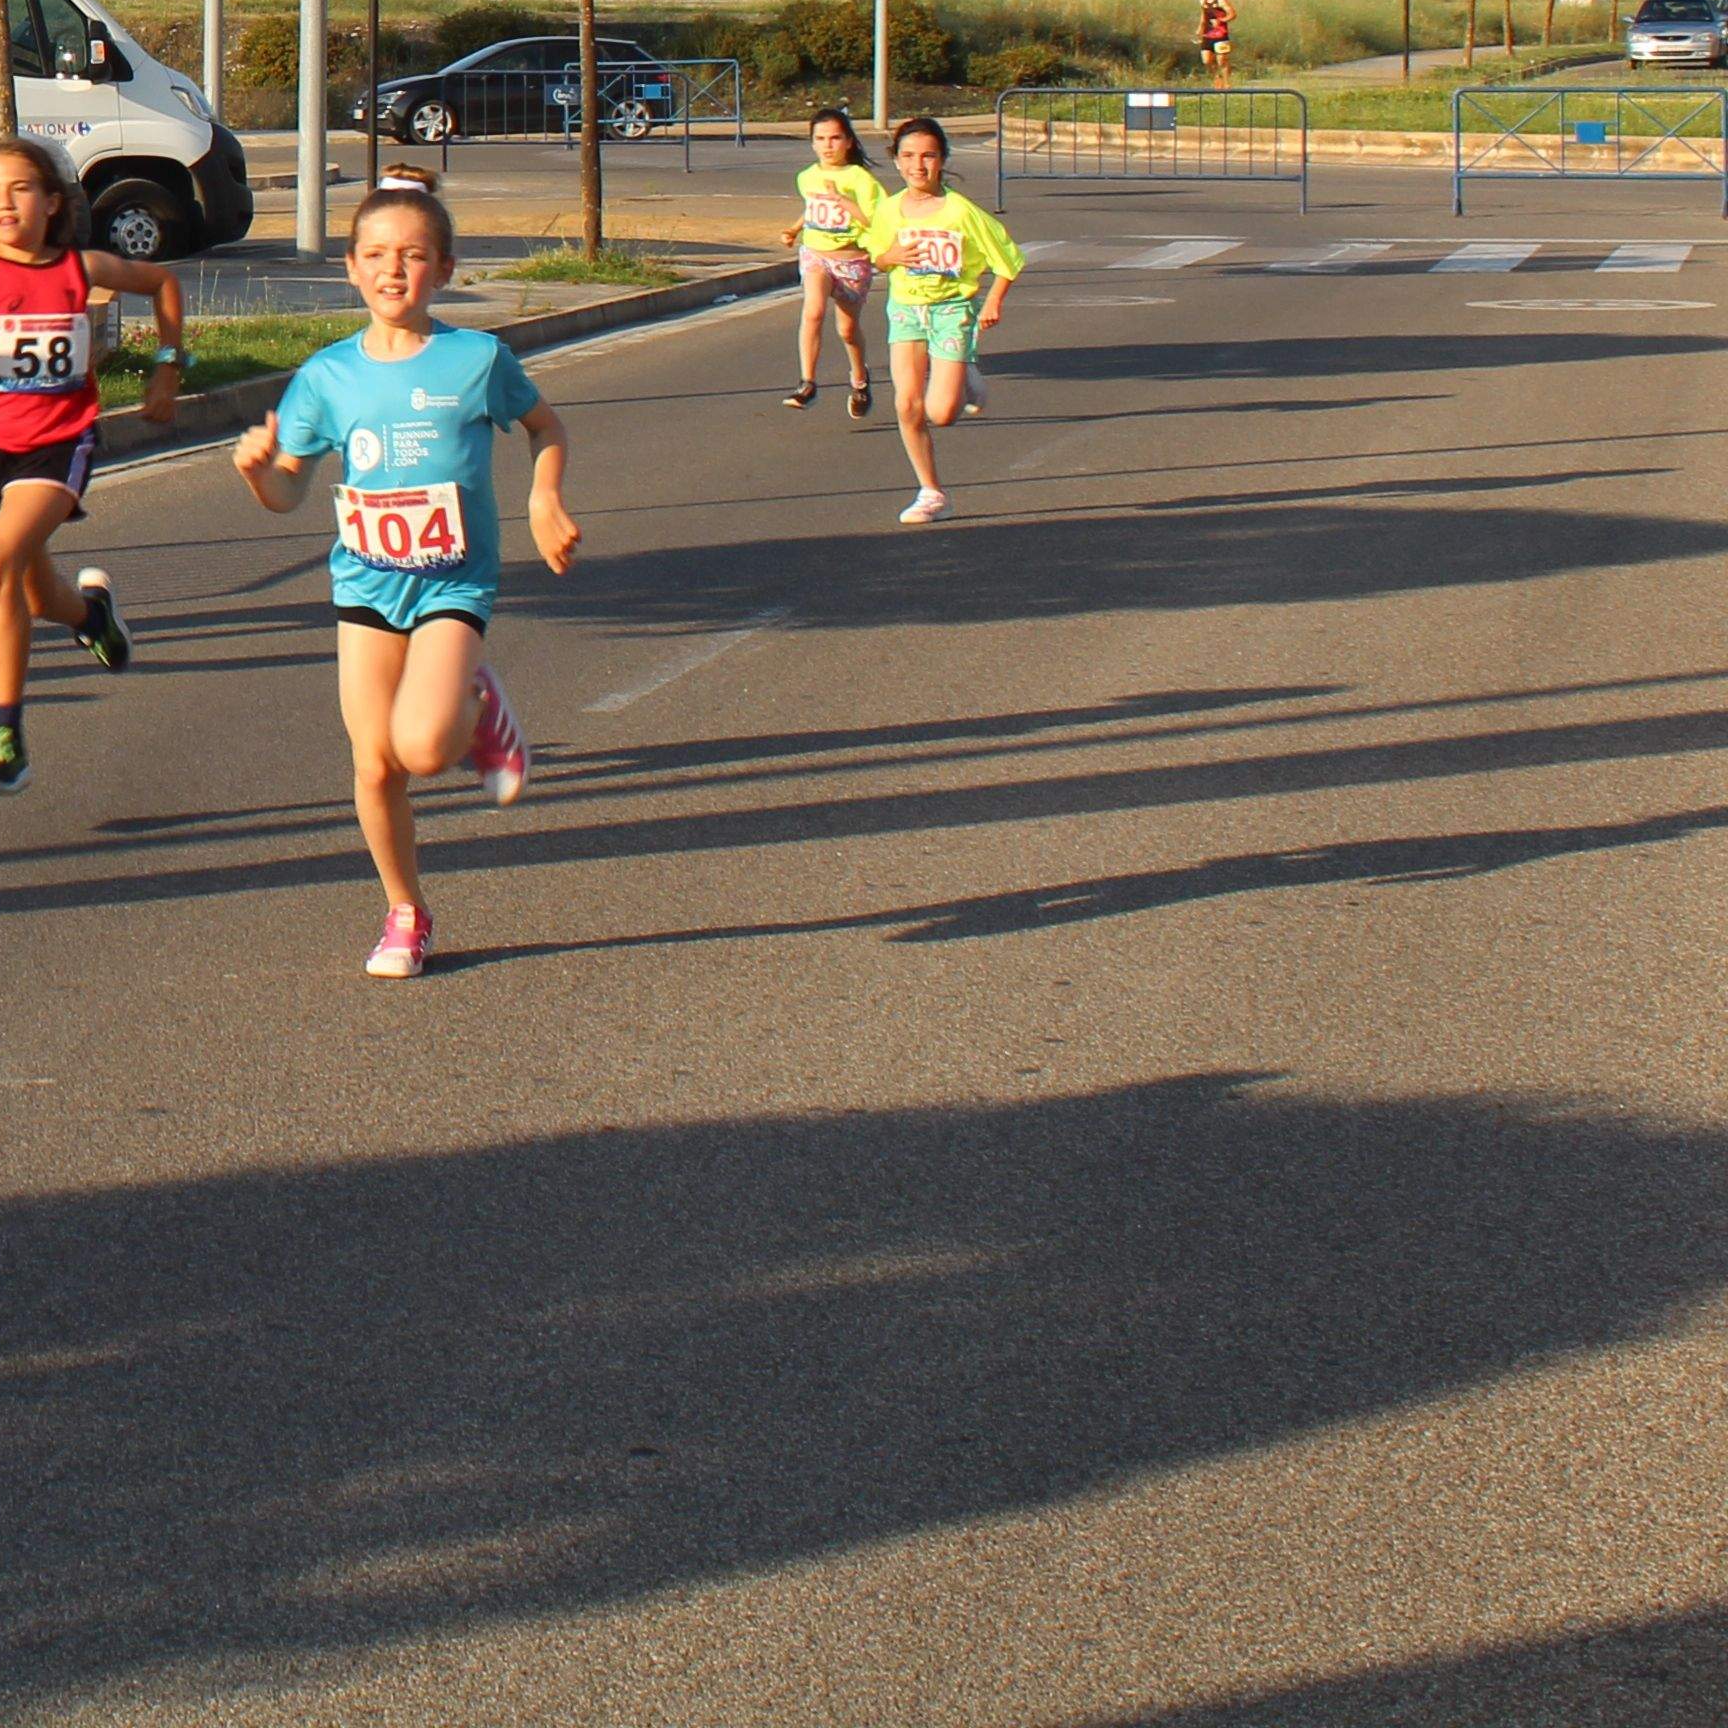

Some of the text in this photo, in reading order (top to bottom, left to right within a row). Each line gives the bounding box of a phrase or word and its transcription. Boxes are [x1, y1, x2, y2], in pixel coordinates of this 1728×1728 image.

[12, 336, 74, 379] 58
[393, 430, 439, 440] RUNNING
[393, 440, 420, 449] PARA
[394, 448, 430, 457] TODOS
[347, 507, 456, 559] 104
